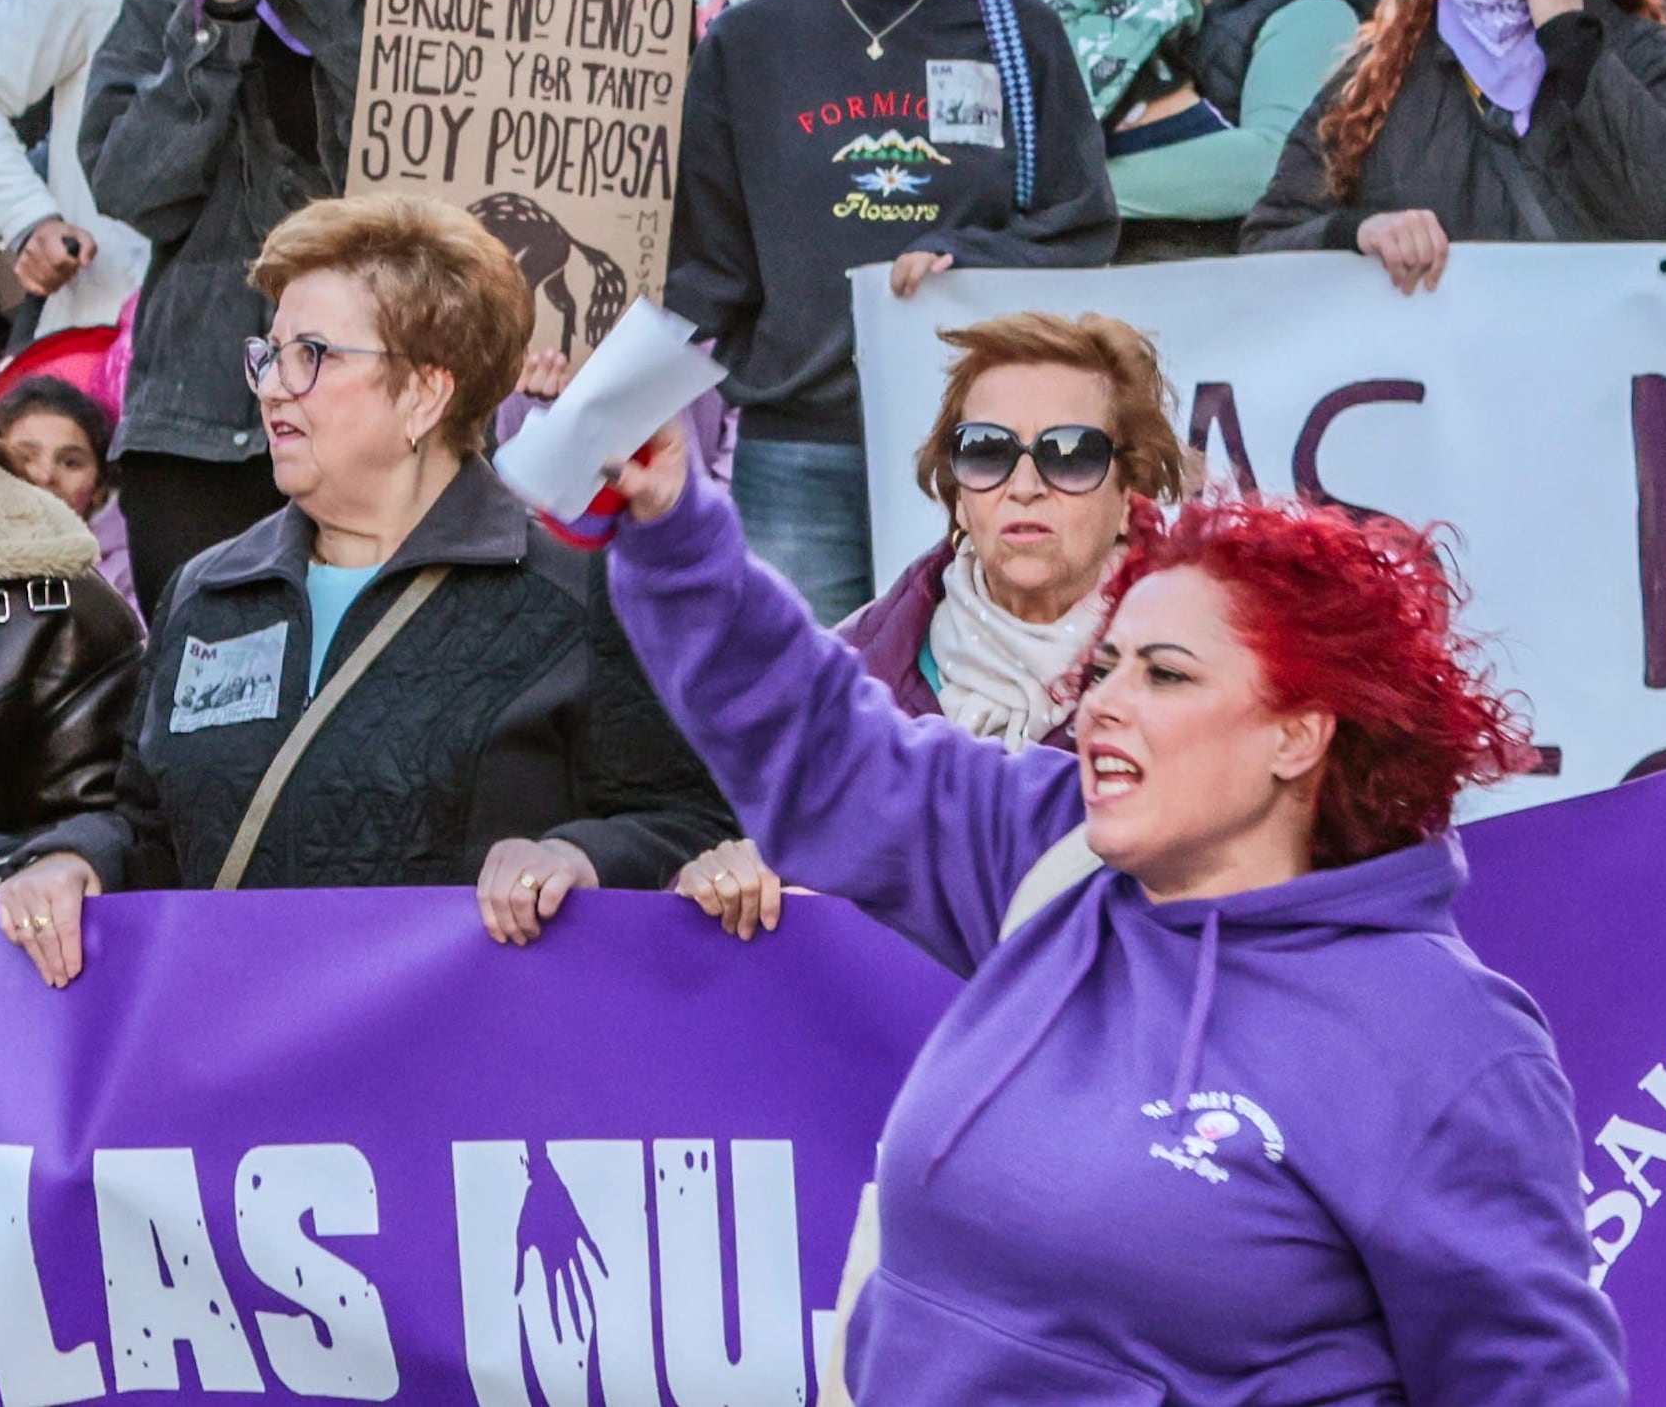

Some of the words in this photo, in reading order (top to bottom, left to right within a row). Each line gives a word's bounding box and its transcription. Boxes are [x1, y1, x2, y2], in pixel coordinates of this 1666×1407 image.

[370, 35, 484, 97] MIEDO
[505, 49, 524, 98] Y
[529, 53, 572, 102] POR
[581, 62, 673, 111] TANTO
[361, 100, 475, 182] SOY
[485, 107, 673, 200] PODEROSA
[833, 192, 940, 221] Flowers
